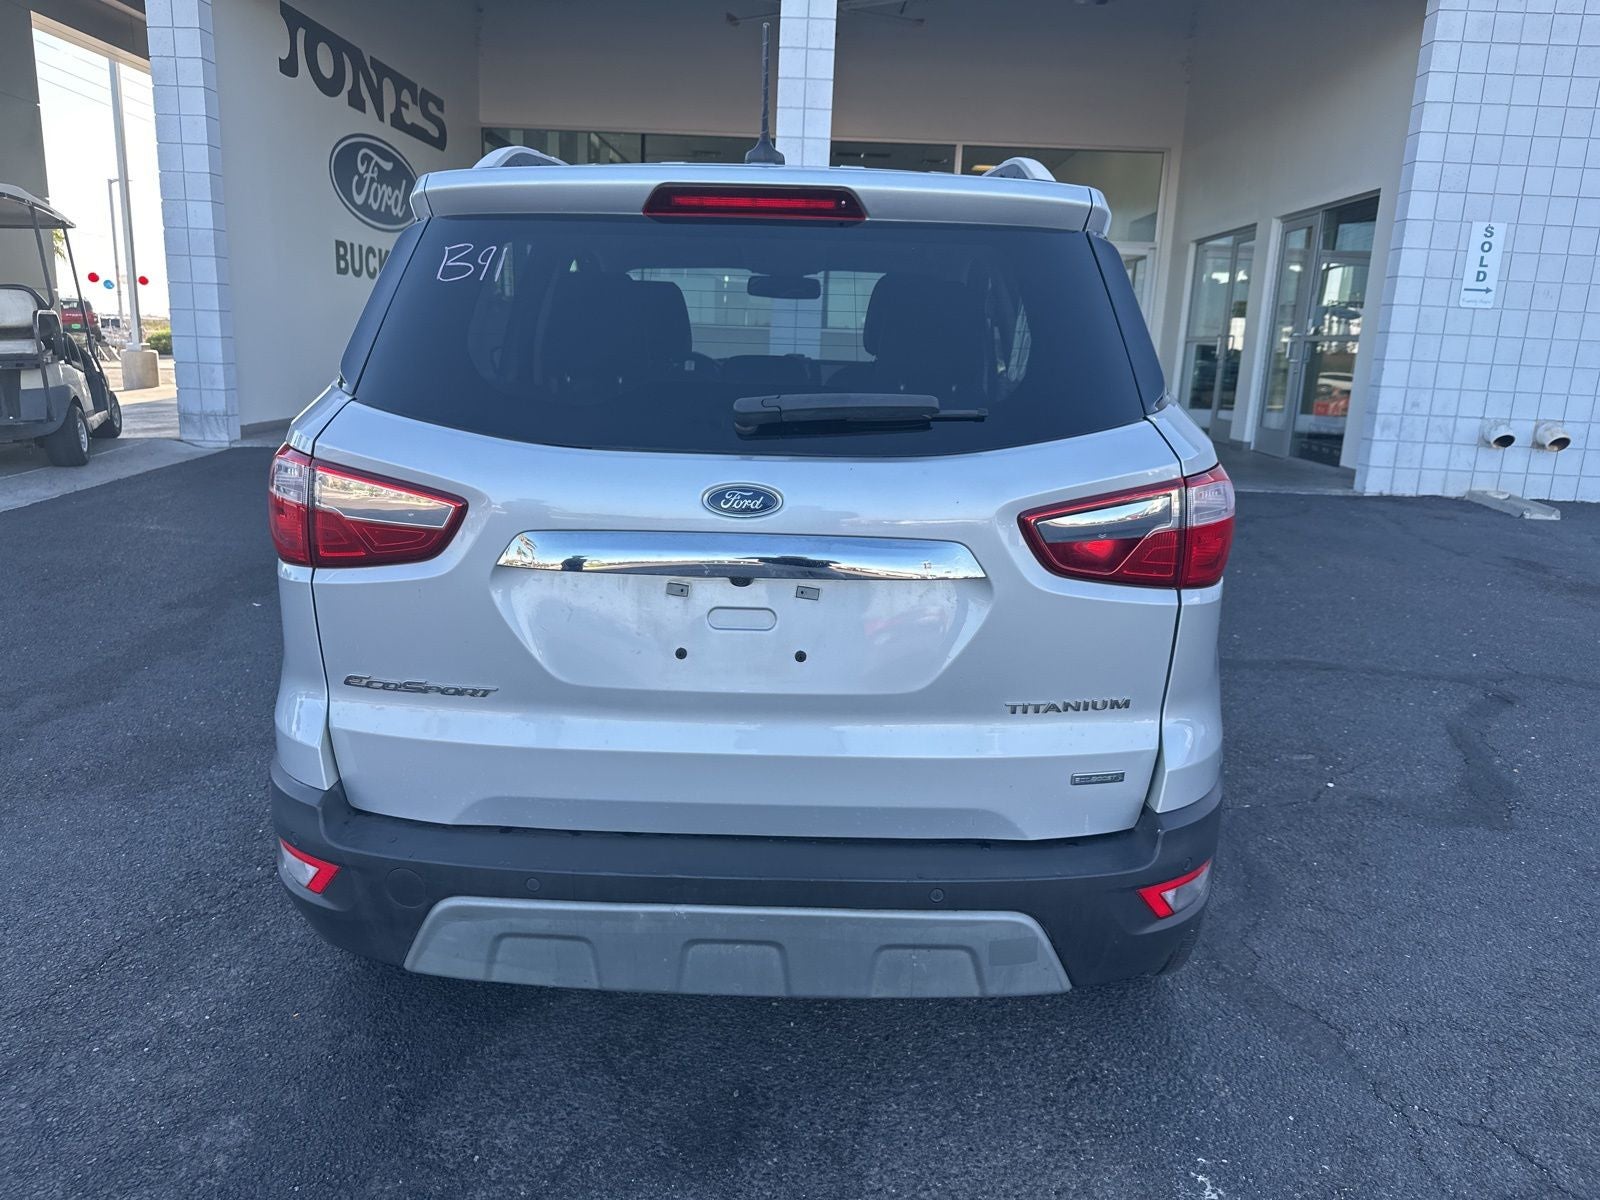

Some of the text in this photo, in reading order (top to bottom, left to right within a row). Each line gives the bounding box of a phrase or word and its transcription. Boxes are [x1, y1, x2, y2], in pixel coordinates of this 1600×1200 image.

[279, 0, 448, 153] JONES
[352, 147, 407, 218] Ford
[436, 243, 508, 282] B91
[1475, 225, 1495, 283] SOLD
[720, 490, 764, 509] Ford
[1004, 698, 1131, 715] TITANIUM
